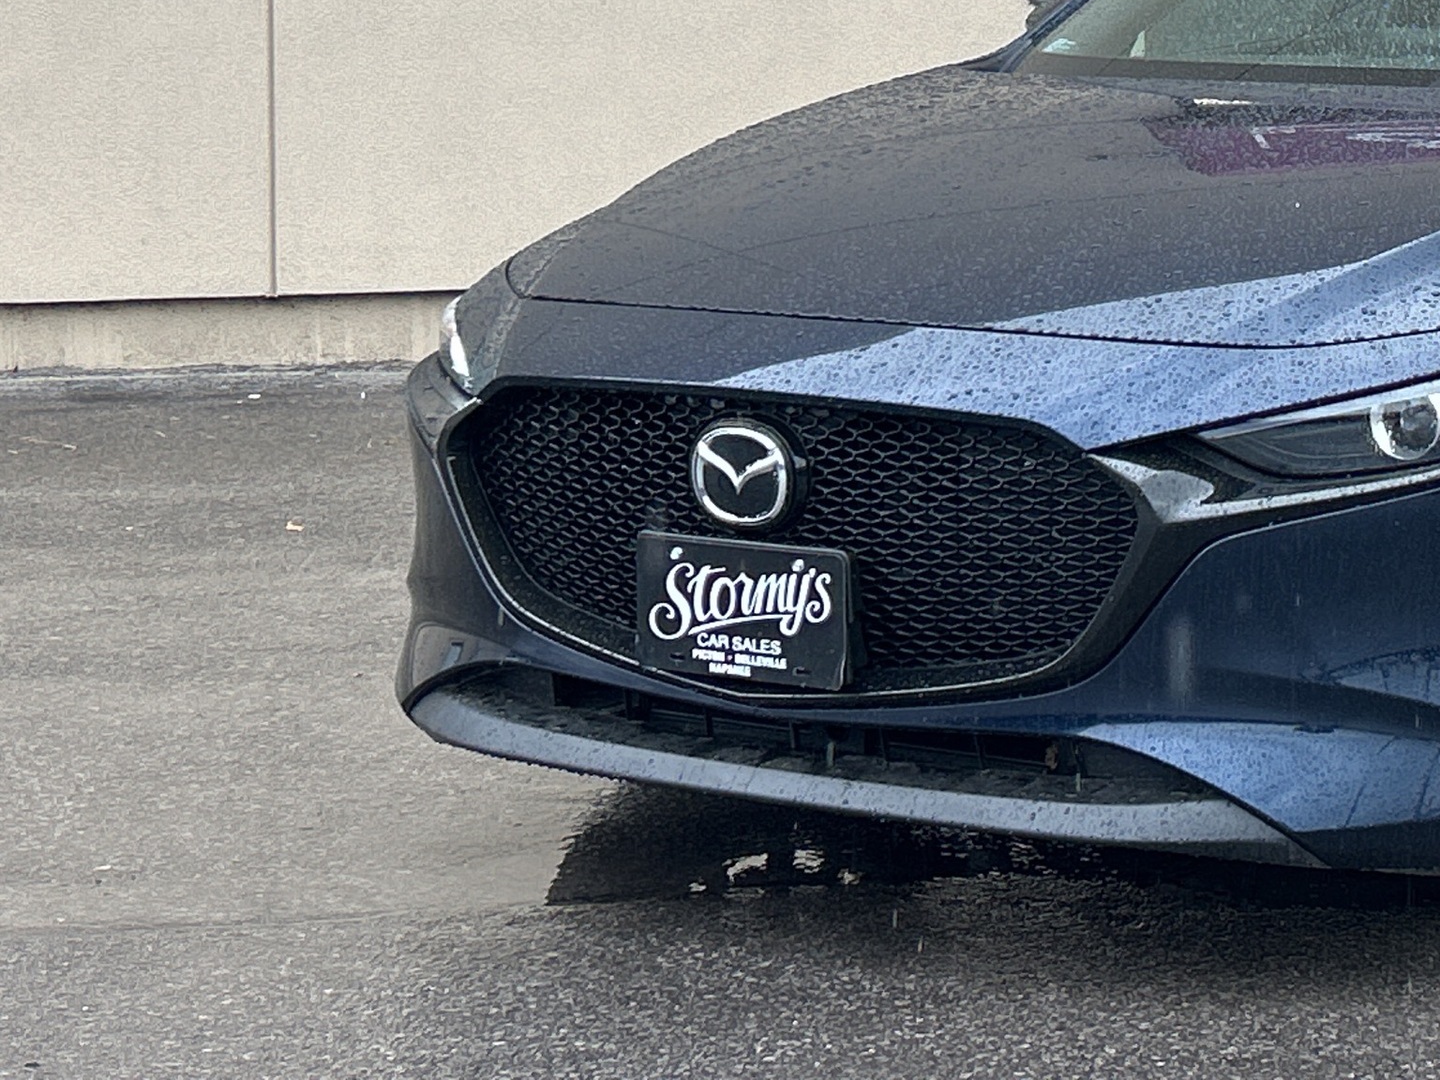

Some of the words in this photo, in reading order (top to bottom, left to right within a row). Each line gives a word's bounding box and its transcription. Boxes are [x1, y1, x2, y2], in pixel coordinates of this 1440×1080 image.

[649, 561, 832, 640] Stormy's
[697, 632, 729, 649] CAR
[732, 636, 782, 655] SALES
